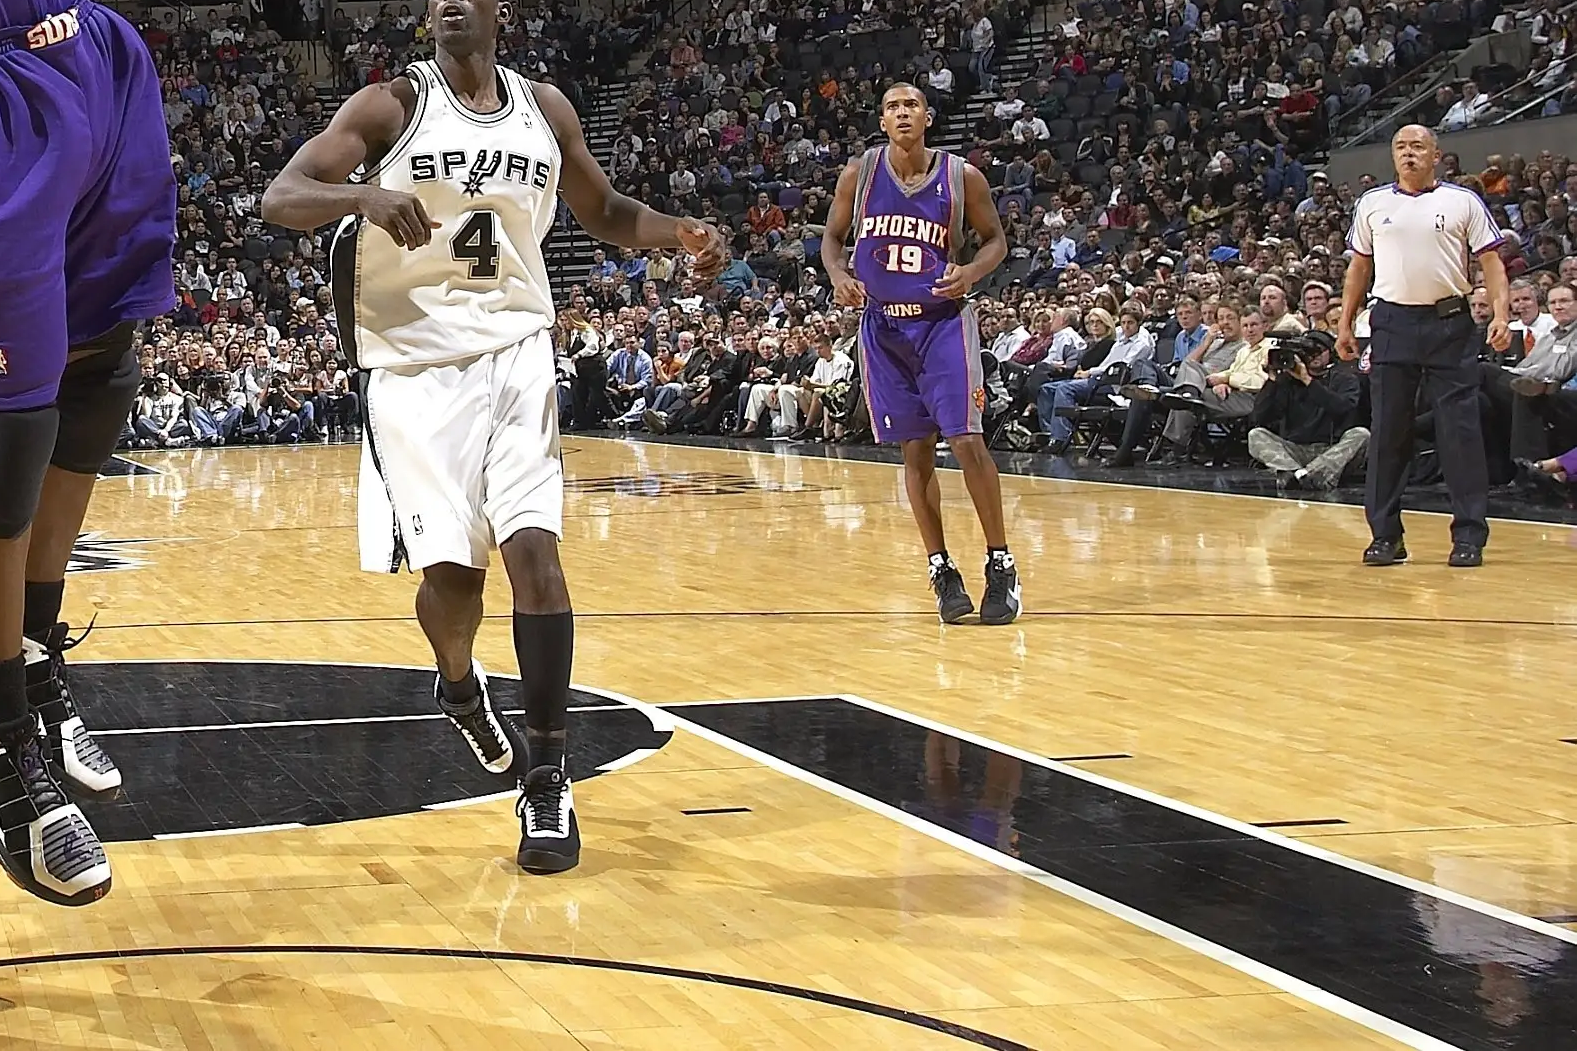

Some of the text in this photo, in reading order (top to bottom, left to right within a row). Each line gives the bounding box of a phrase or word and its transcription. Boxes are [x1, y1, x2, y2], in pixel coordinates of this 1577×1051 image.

[409, 149, 551, 195] SPURS
[449, 209, 501, 280] 4
[859, 214, 948, 249] PHOENIX
[886, 244, 923, 274] 19
